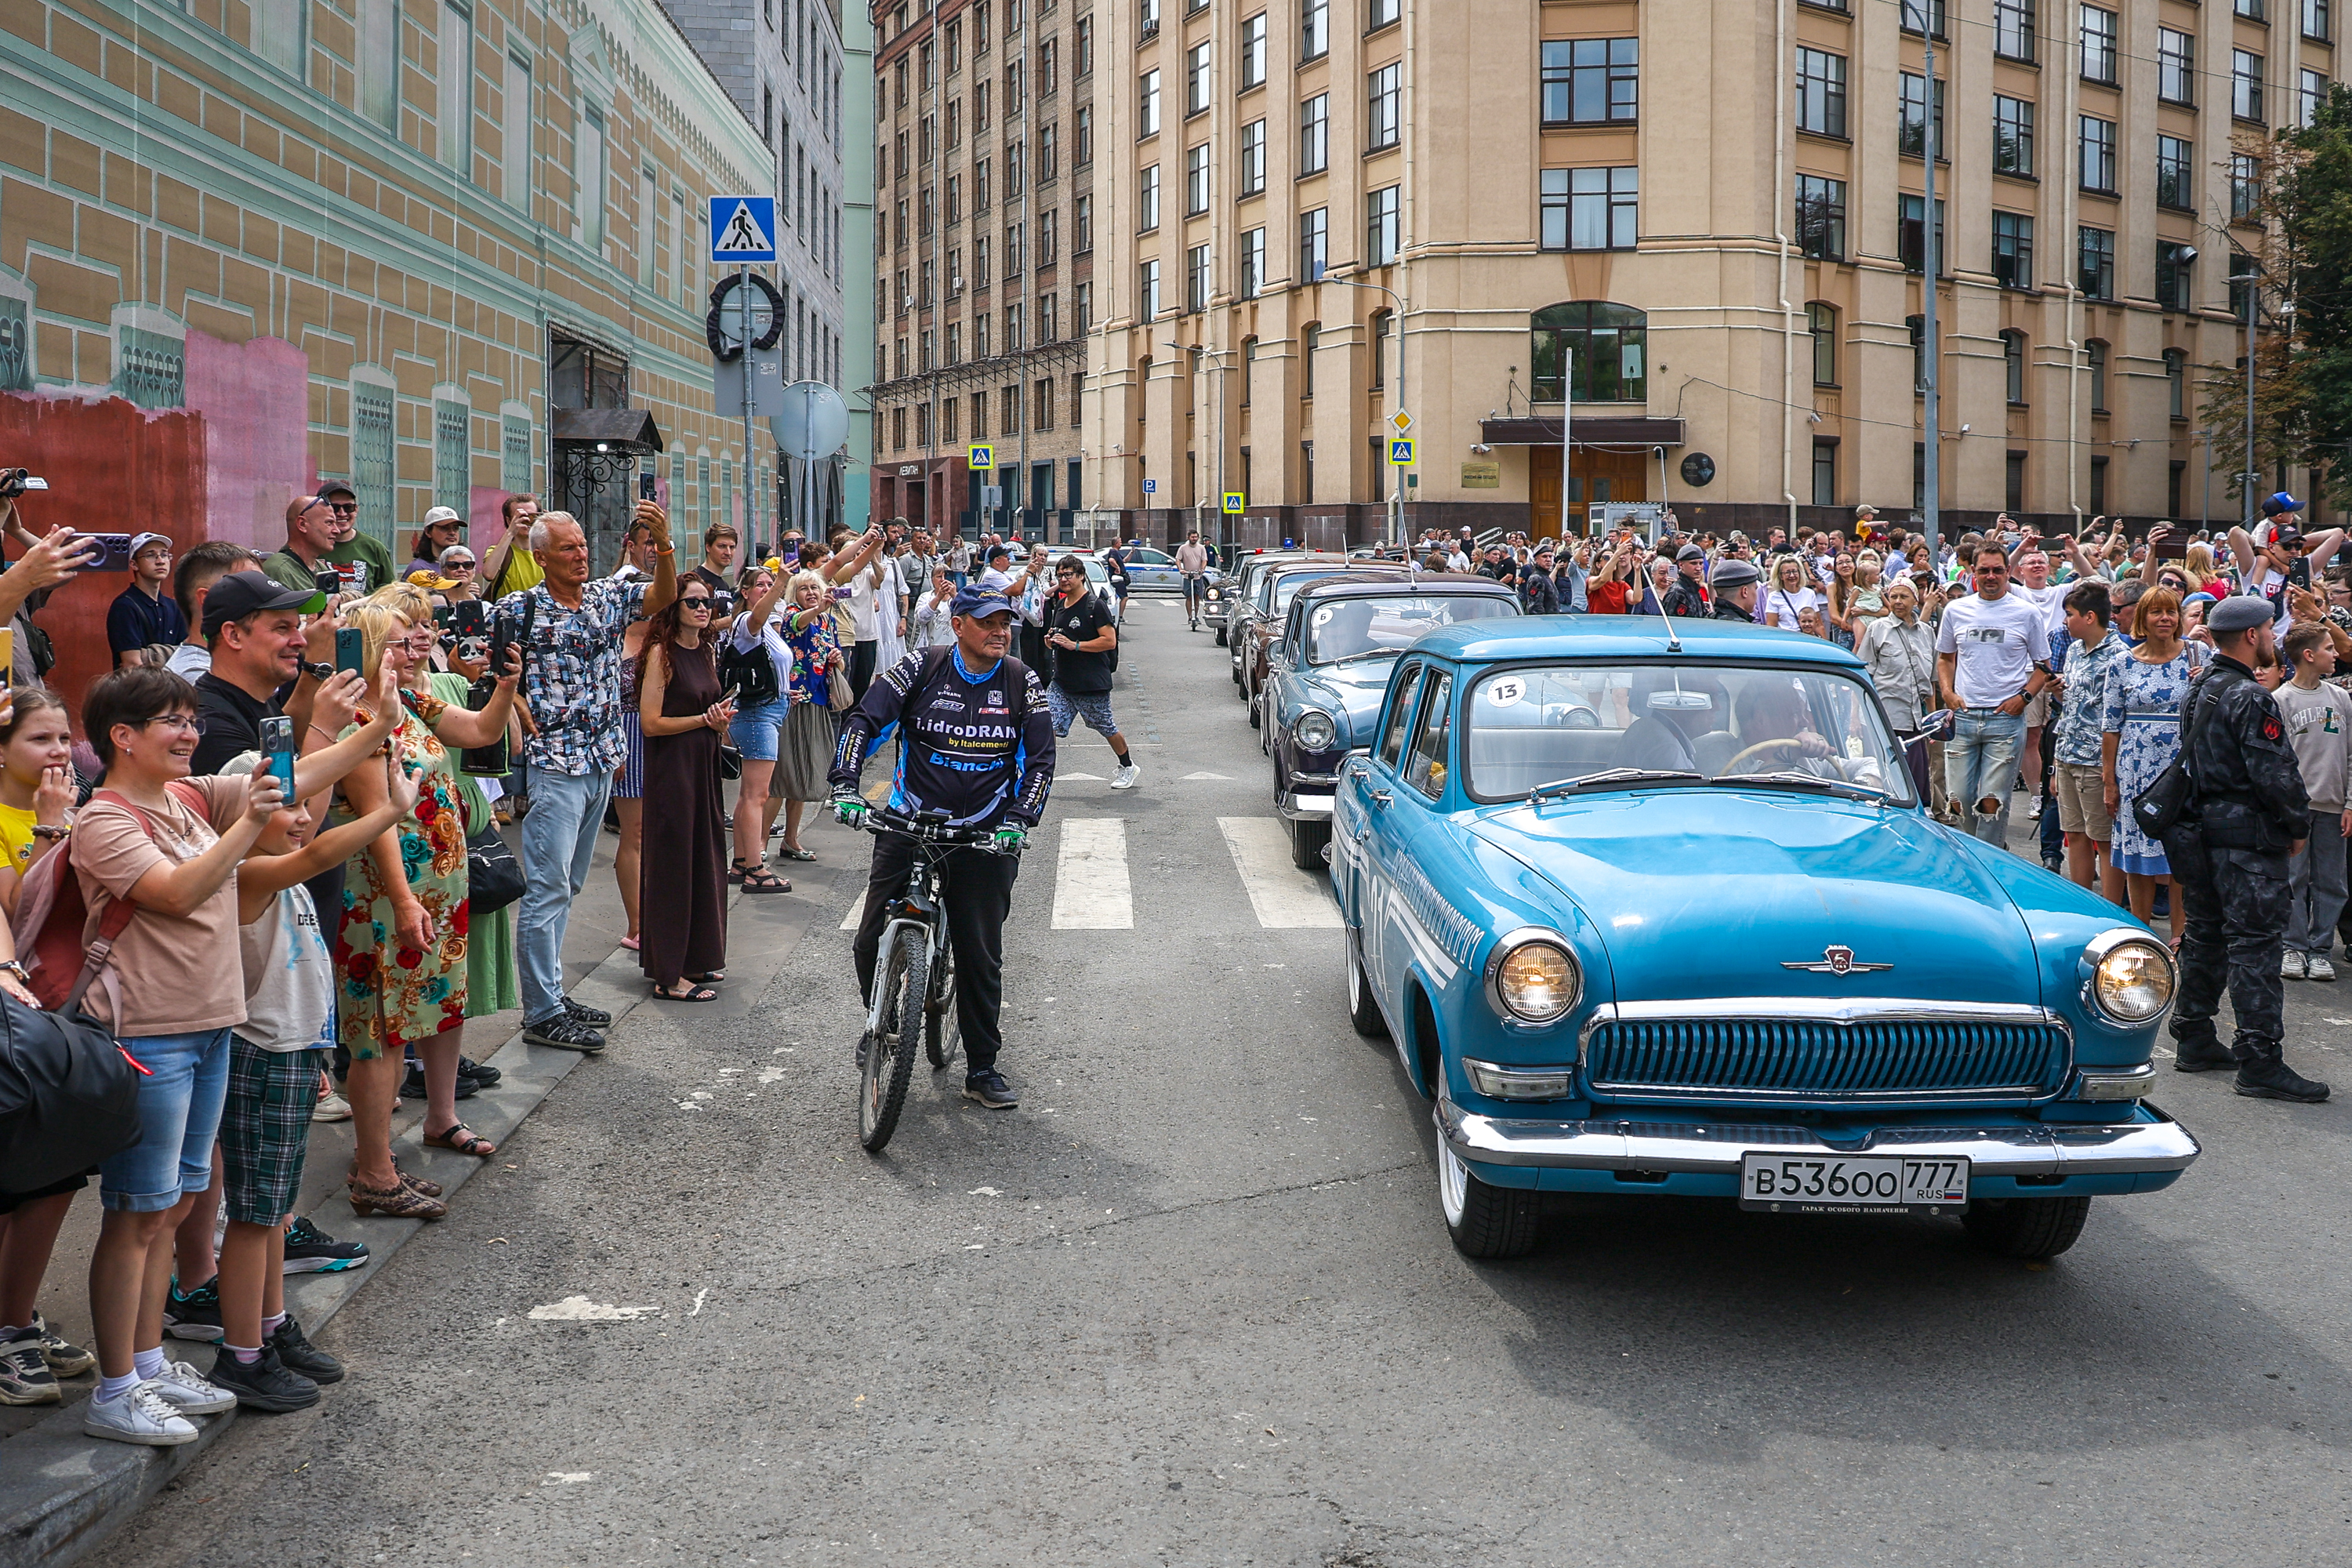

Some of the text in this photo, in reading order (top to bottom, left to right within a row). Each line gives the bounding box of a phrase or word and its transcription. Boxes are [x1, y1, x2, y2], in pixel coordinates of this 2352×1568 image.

[898, 464, 919, 476] ЛЕВИТАН
[1494, 684, 1517, 700] 13
[949, 737, 1009, 749] by Italcementi
[929, 752, 1005, 772] Bianchi
[1755, 1161, 1958, 1198] В536ОО 777
[1917, 1189, 1943, 1199] RUS
